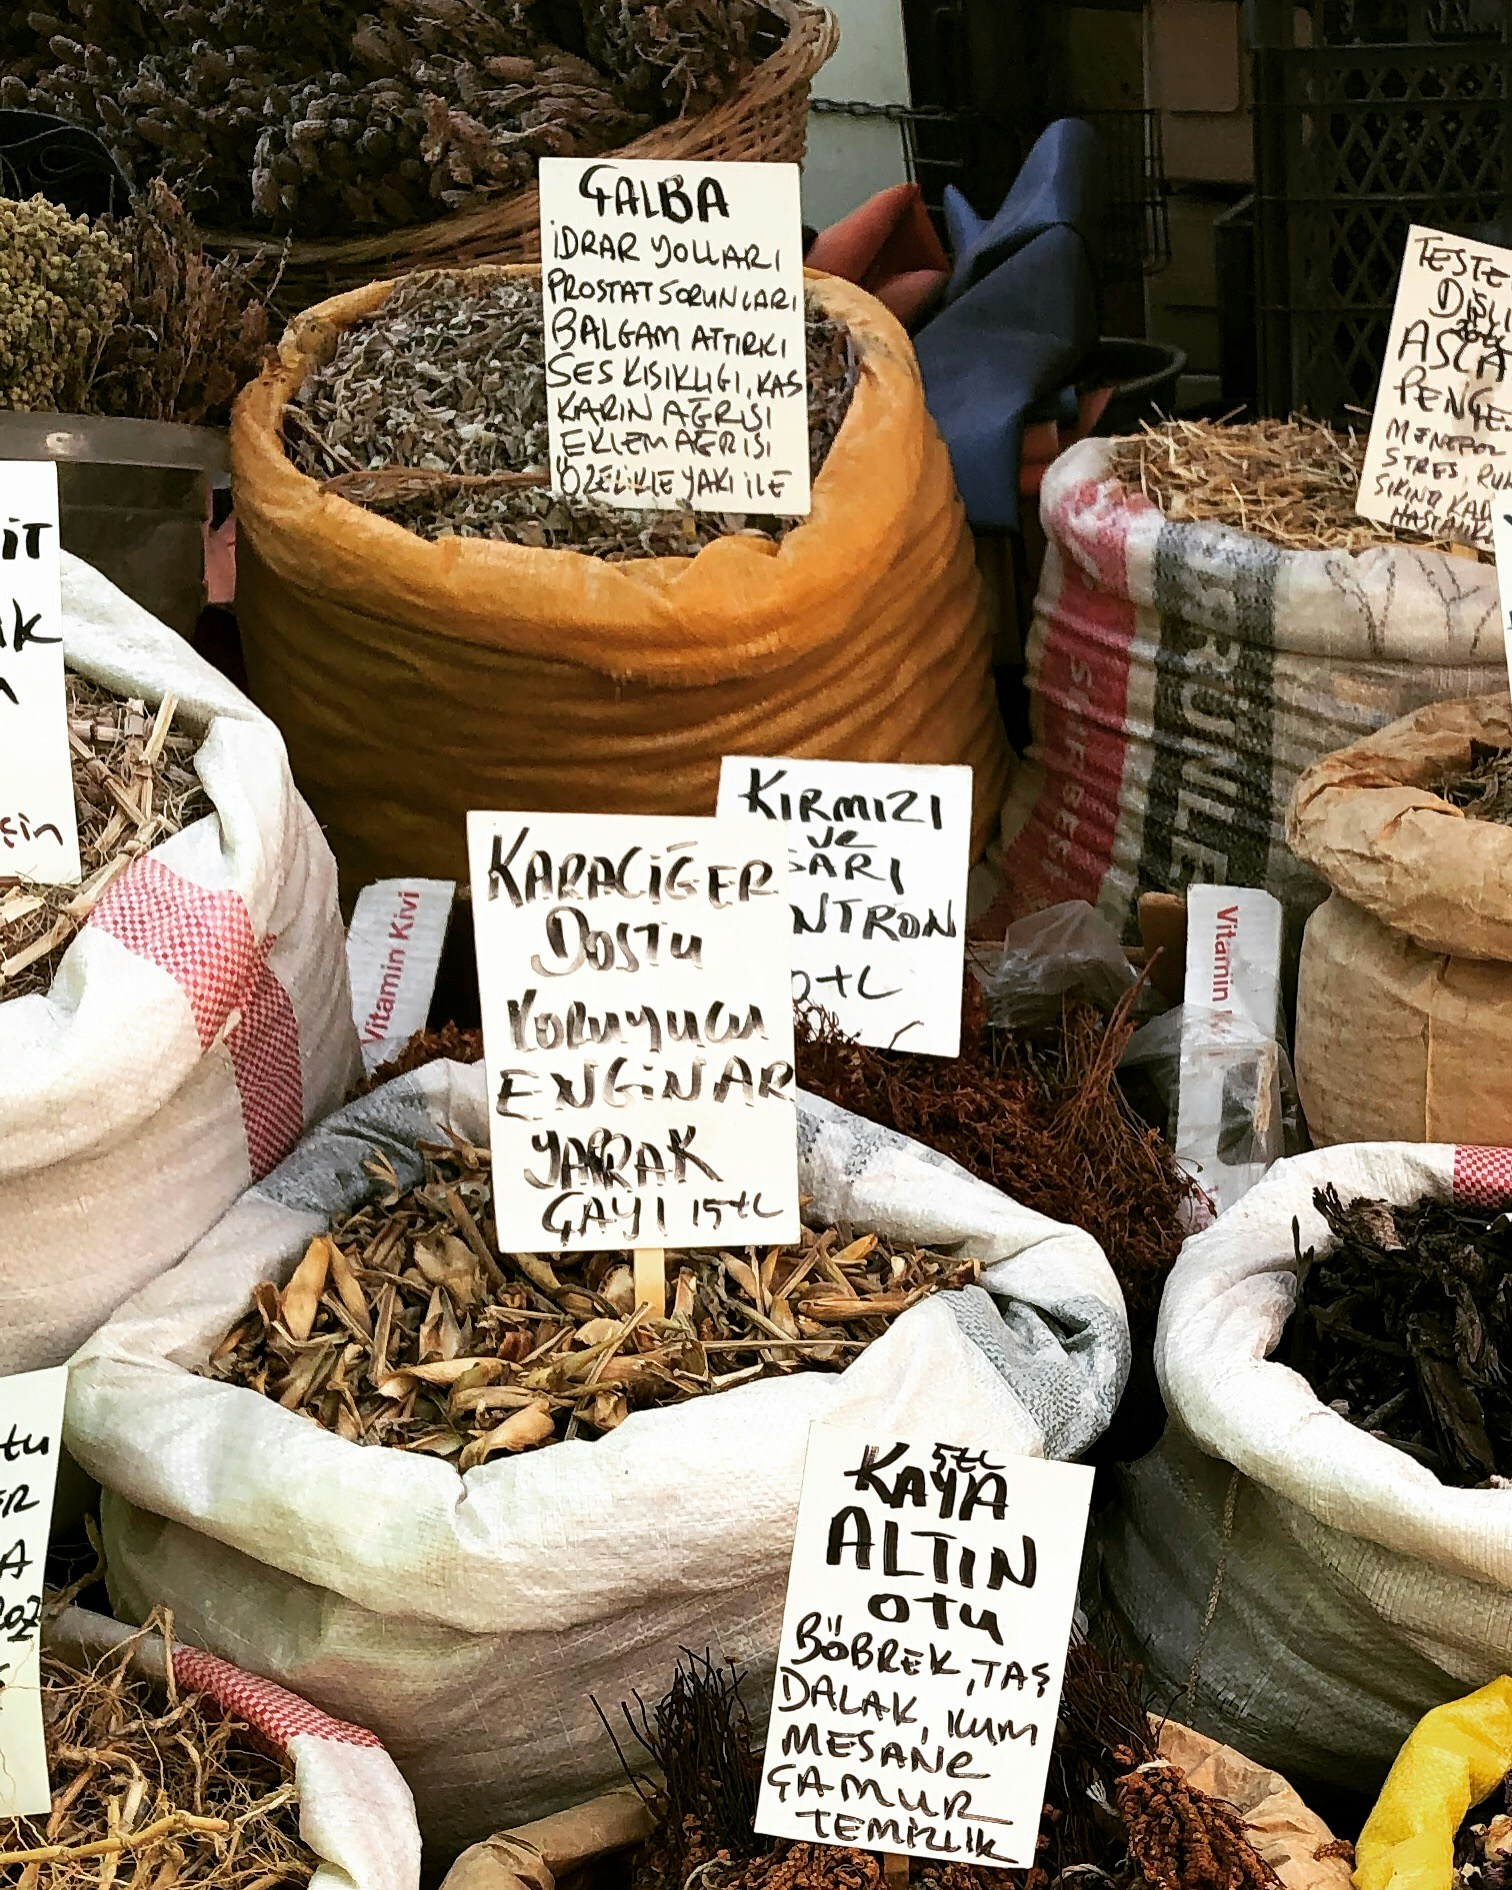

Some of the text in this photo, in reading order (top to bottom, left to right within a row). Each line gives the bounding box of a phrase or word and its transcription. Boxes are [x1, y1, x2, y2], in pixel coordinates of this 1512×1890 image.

[548, 267, 653, 303] PROSTAT
[546, 352, 614, 388] SES
[738, 767, 943, 830] KIRMIZI
[359, 890, 420, 1045] Vitamin Kivi
[530, 905, 703, 977] DOSTU
[1211, 904, 1240, 1003] Vitamin
[541, 1190, 669, 1247] ÇAYI
[844, 1442, 1010, 1521] KAYA
[826, 1505, 1037, 1591] ALTIN
[767, 1763, 1014, 1826] ÇAMUR
